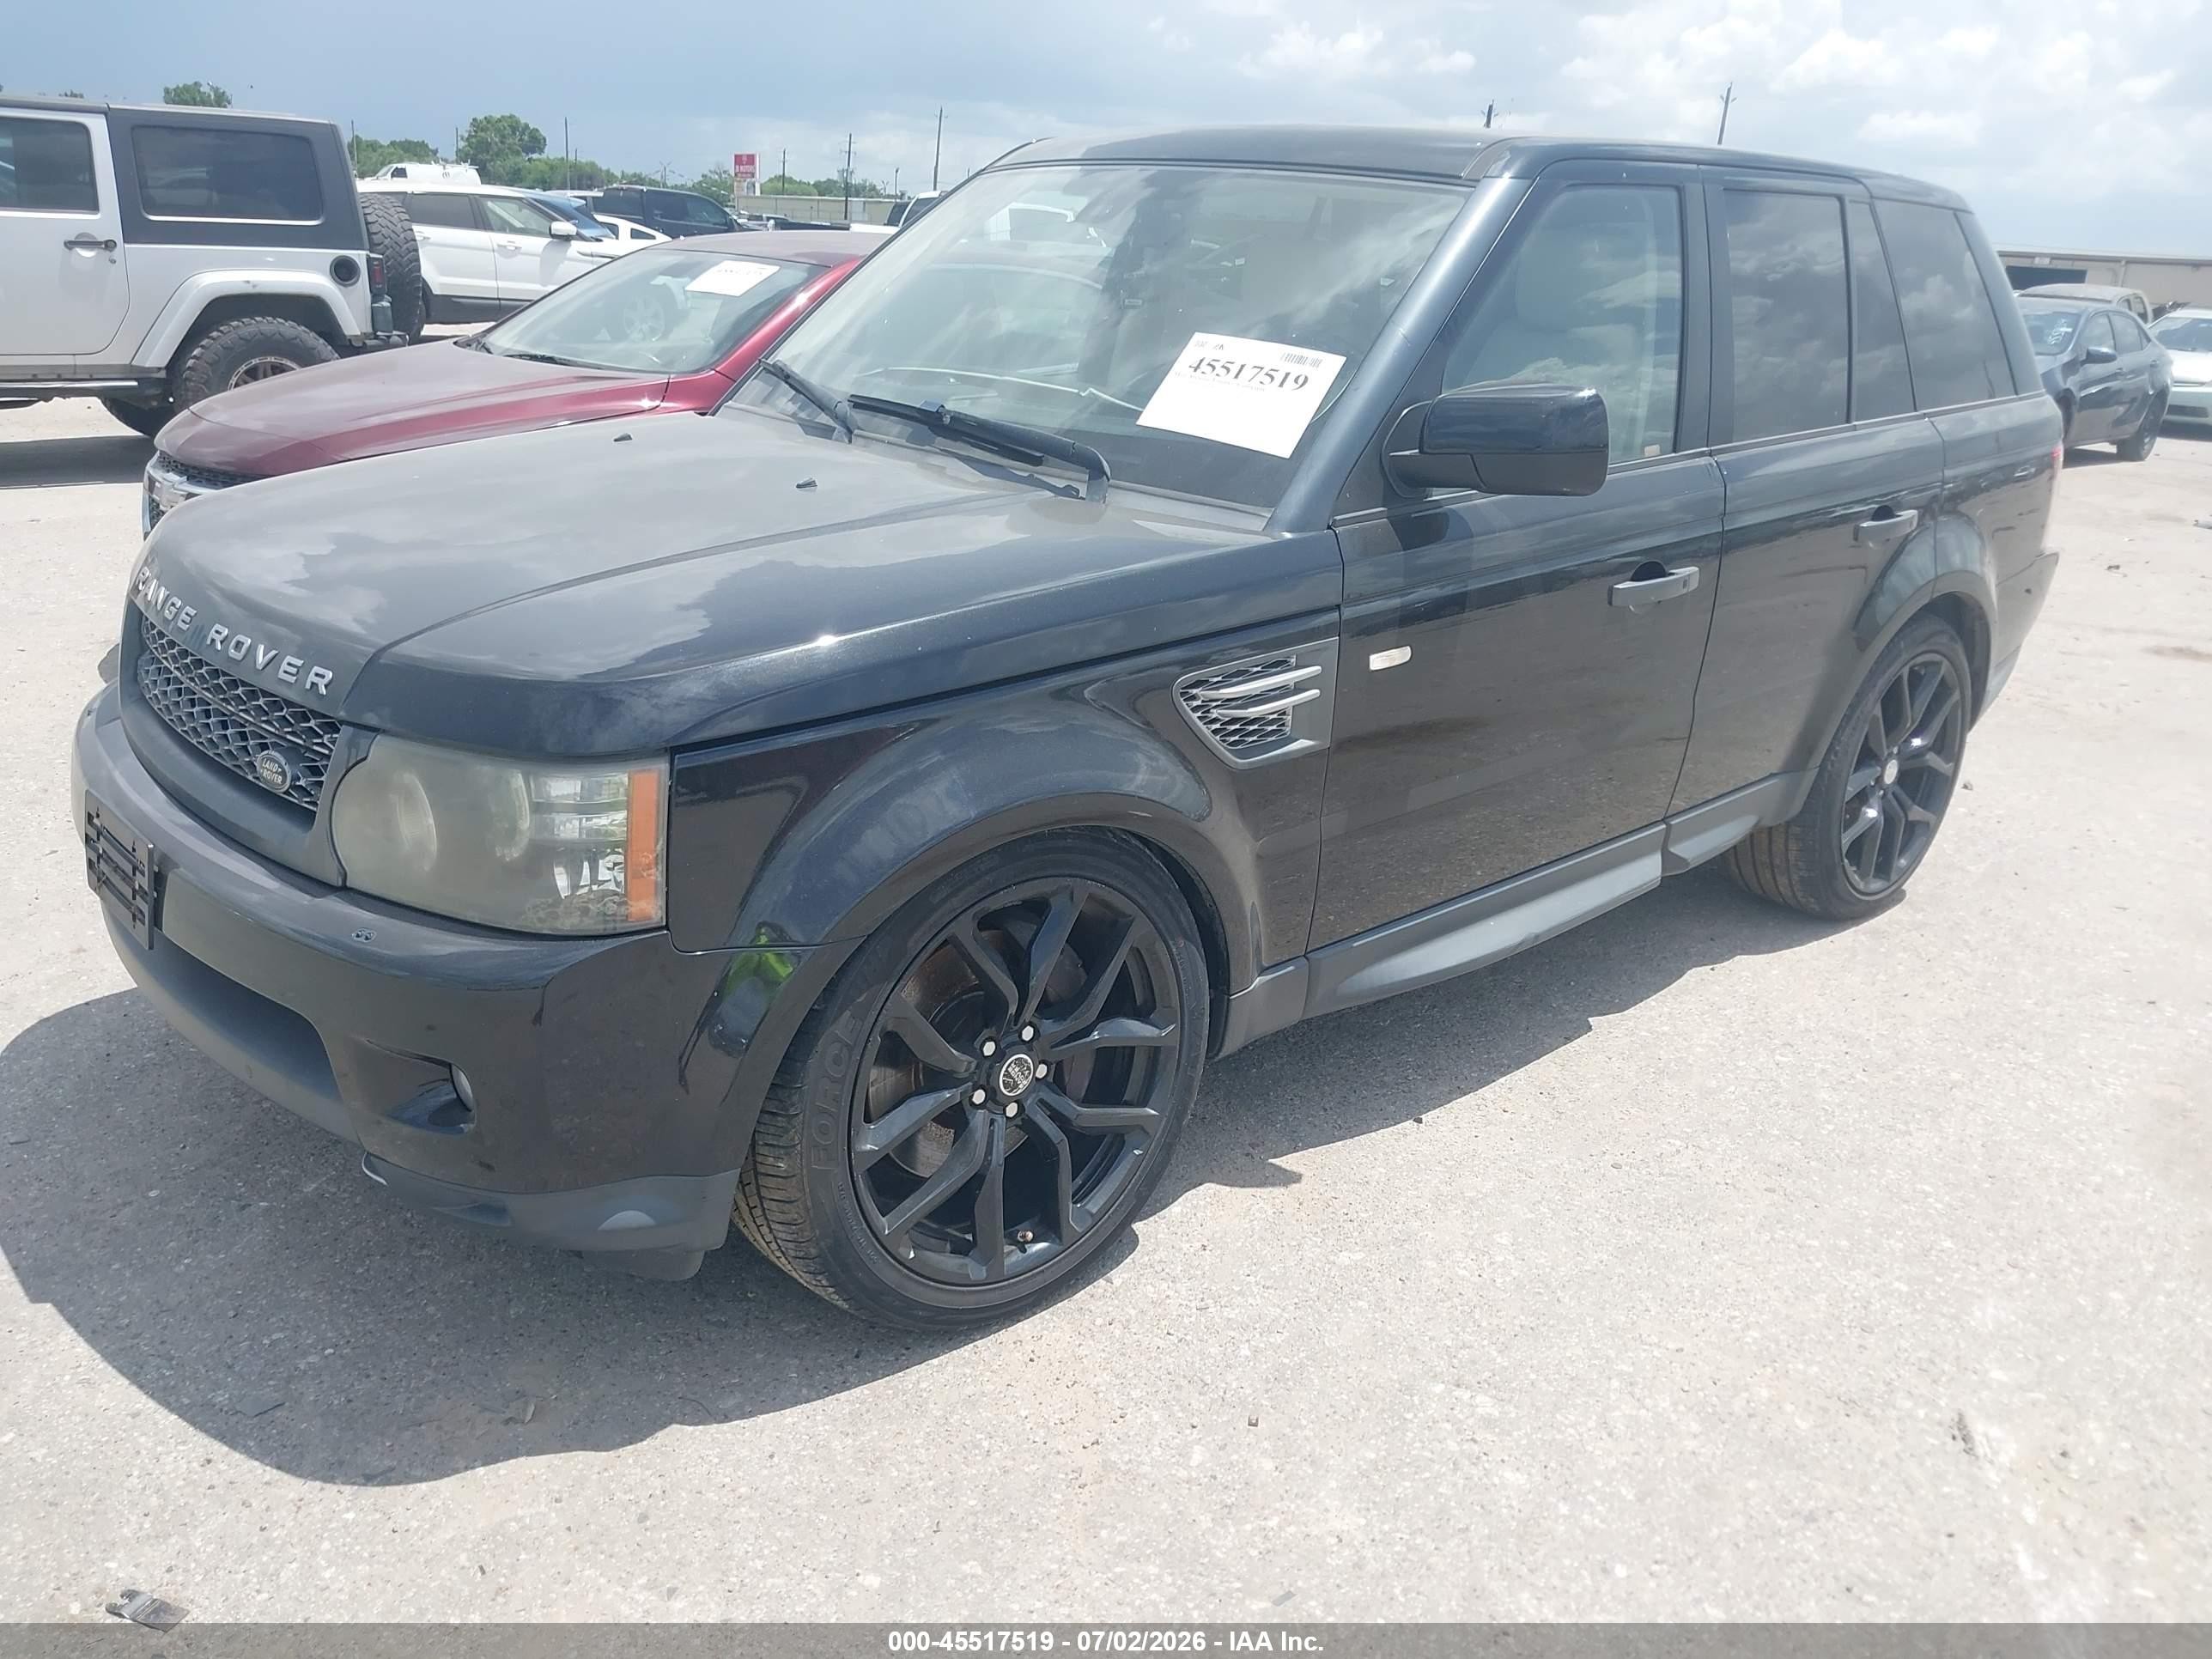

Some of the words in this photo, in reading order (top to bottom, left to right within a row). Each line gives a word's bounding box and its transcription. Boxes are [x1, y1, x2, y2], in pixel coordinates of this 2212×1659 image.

[1188, 356, 1309, 392] 45517519
[135, 566, 198, 632] RANGE
[206, 623, 333, 696] ROVER
[262, 757, 279, 773] LAND
[263, 769, 283, 785] ROVER
